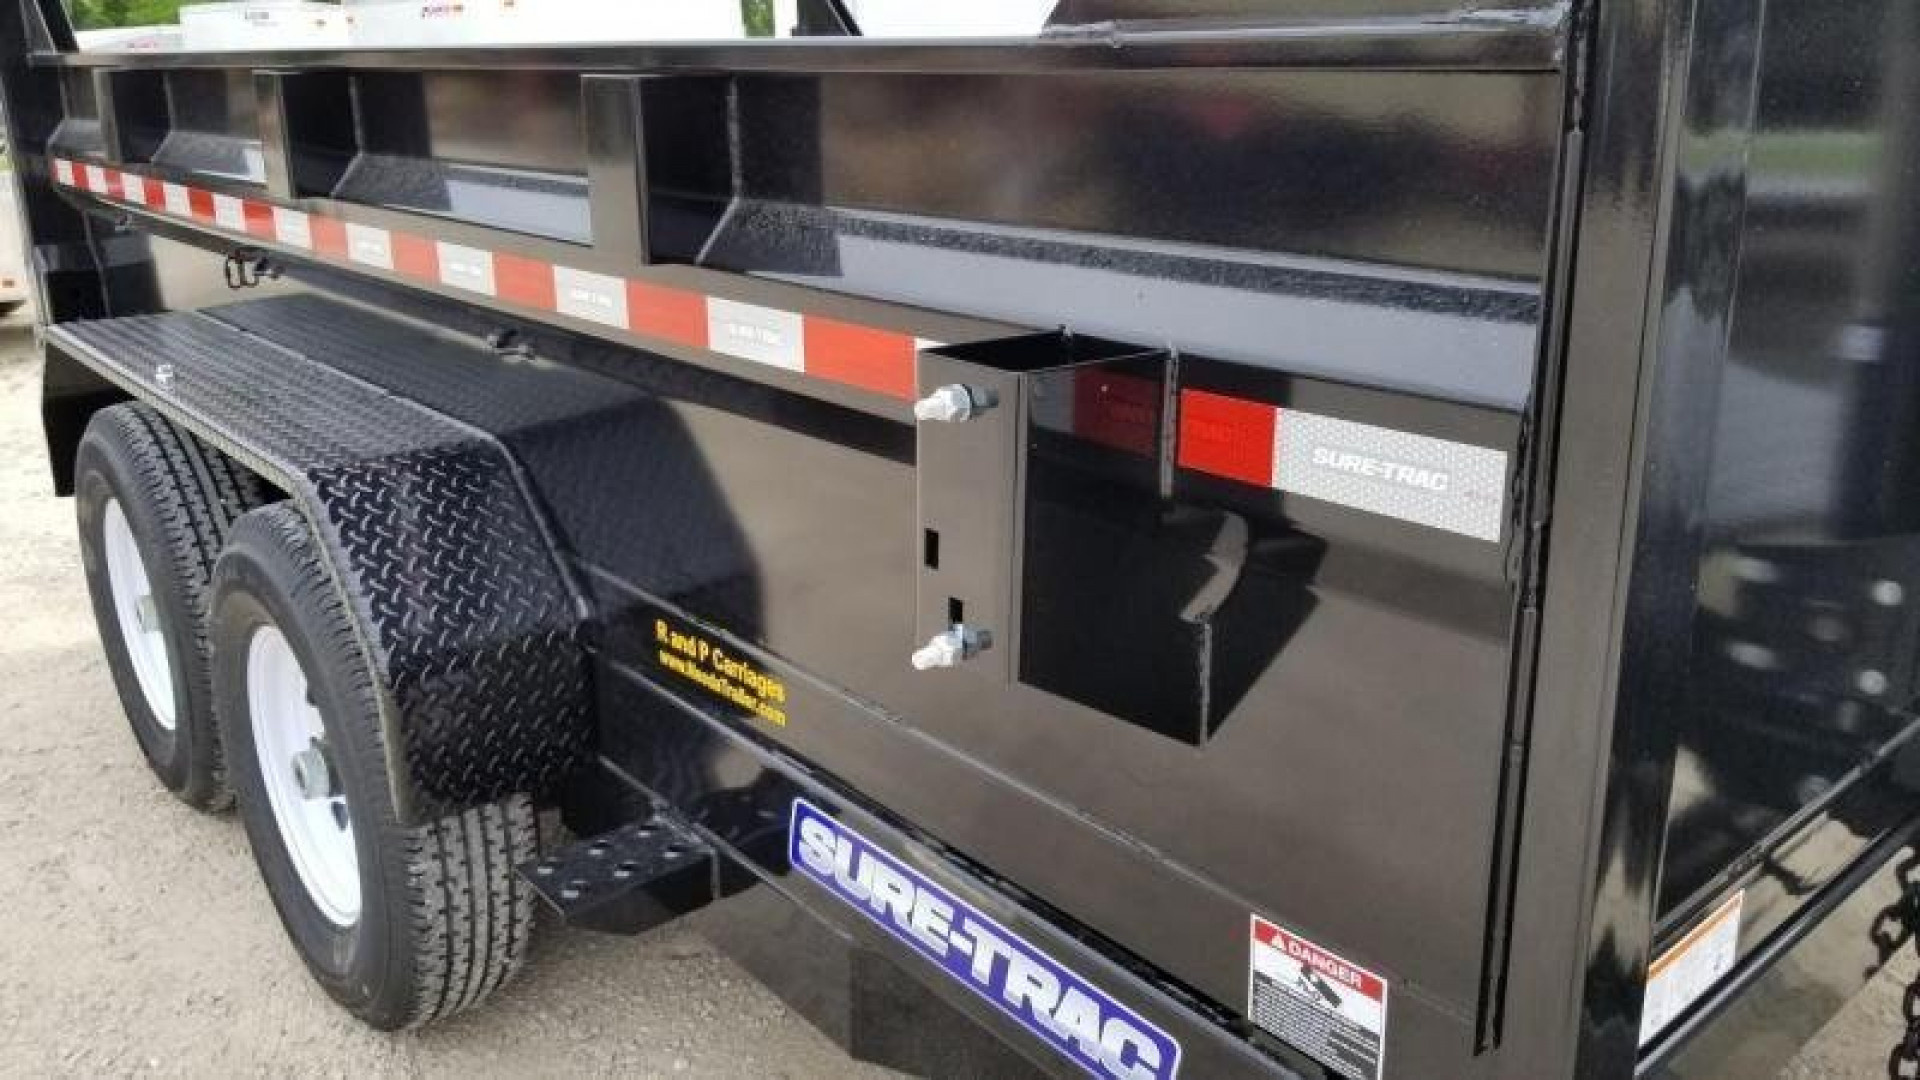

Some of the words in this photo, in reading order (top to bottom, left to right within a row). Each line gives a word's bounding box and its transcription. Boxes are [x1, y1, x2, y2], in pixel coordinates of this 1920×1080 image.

[1313, 447, 1449, 491] SURE-TRAC
[656, 619, 668, 643] R
[671, 631, 696, 658] and
[699, 639, 709, 661] P
[712, 648, 786, 702] Carriages
[798, 815, 1161, 1080] SURE-TRAC
[1288, 940, 1362, 988] DANGER
